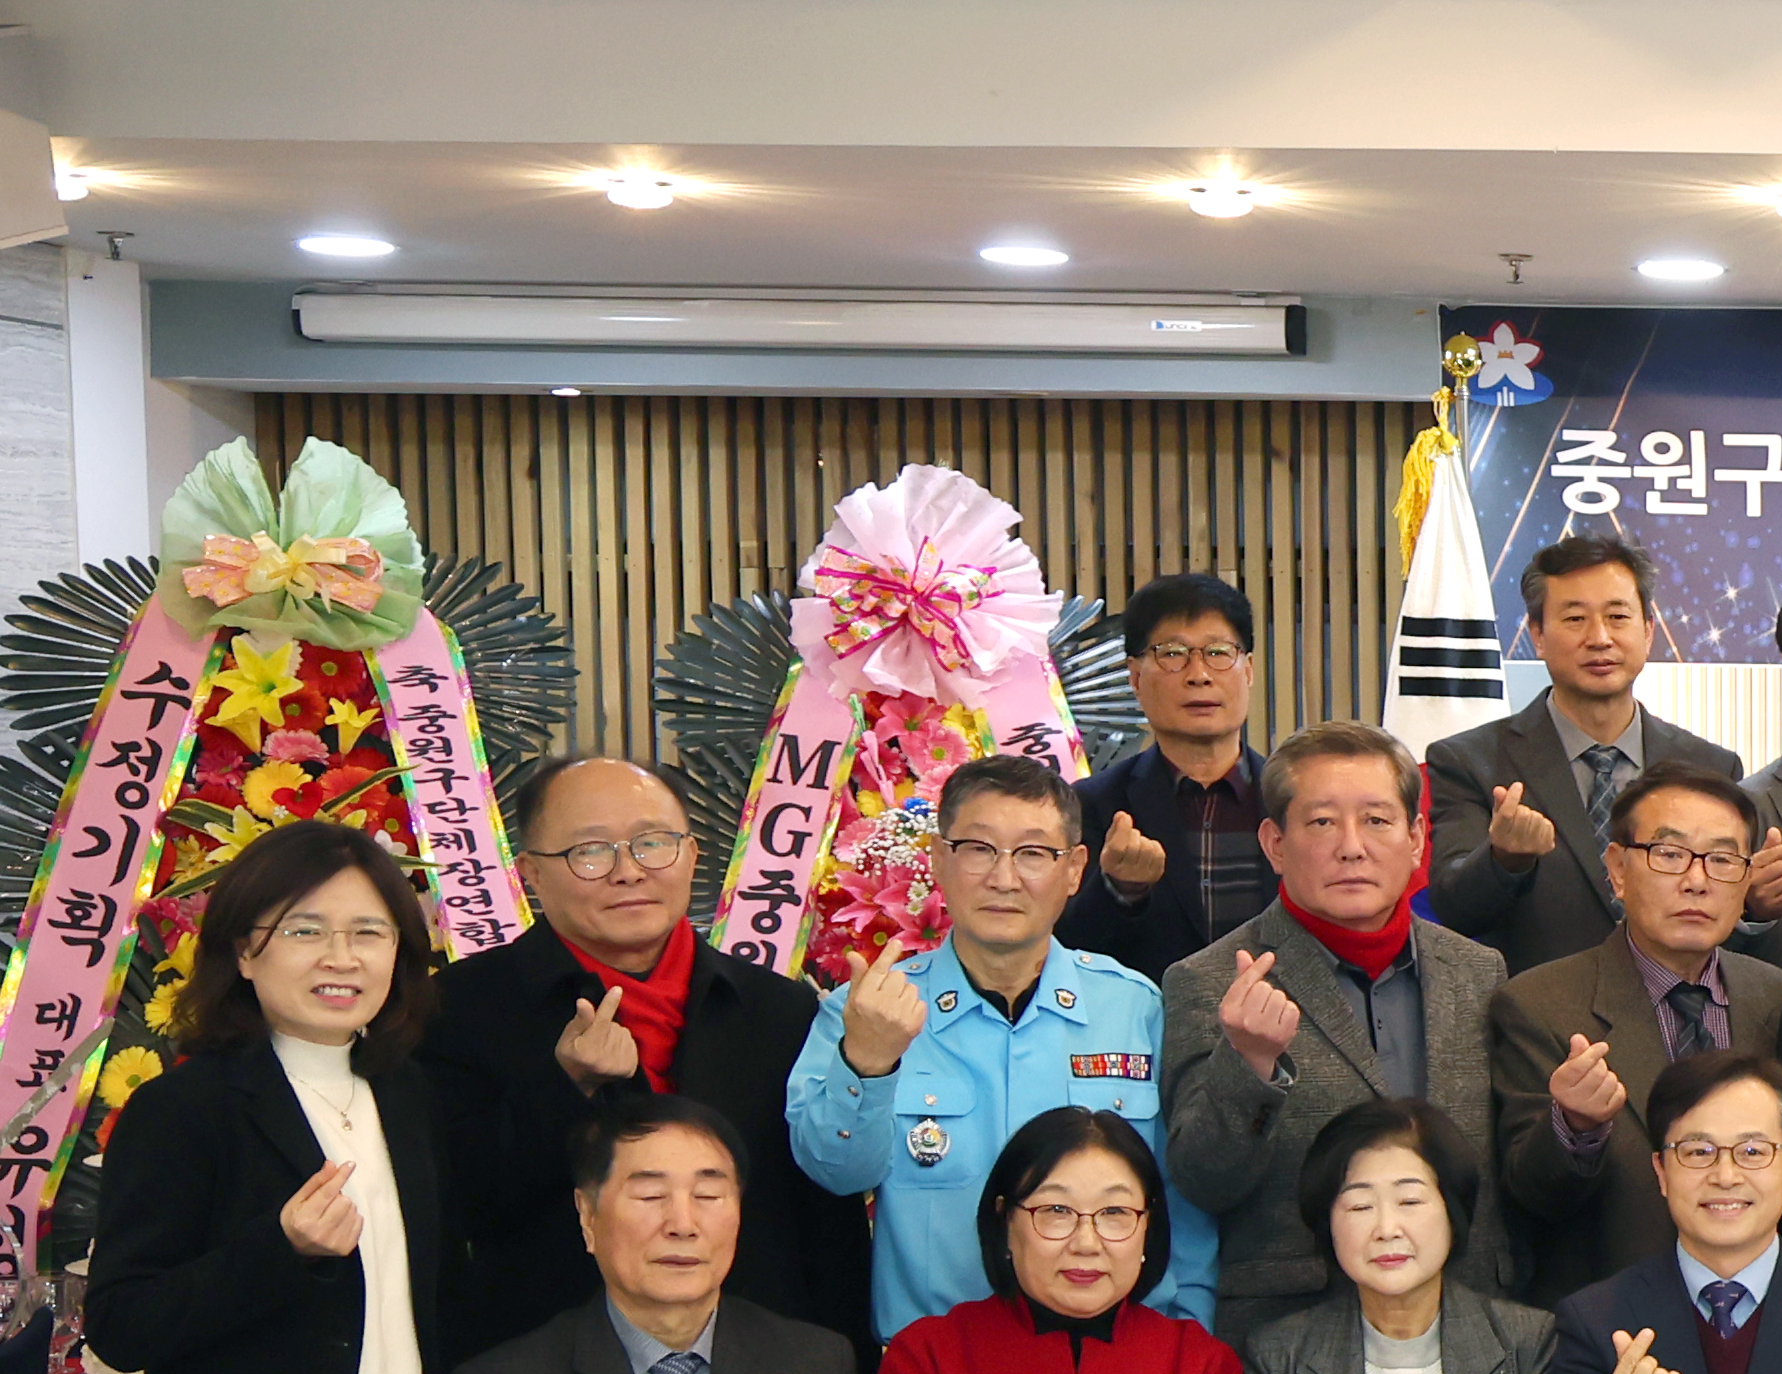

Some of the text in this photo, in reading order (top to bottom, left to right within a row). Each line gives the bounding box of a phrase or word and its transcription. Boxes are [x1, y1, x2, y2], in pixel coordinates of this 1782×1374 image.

[47, 661, 193, 968] 수정기획
[387, 665, 518, 956] 축 중원구단체장연합
[15, 992, 83, 1094] 대표
